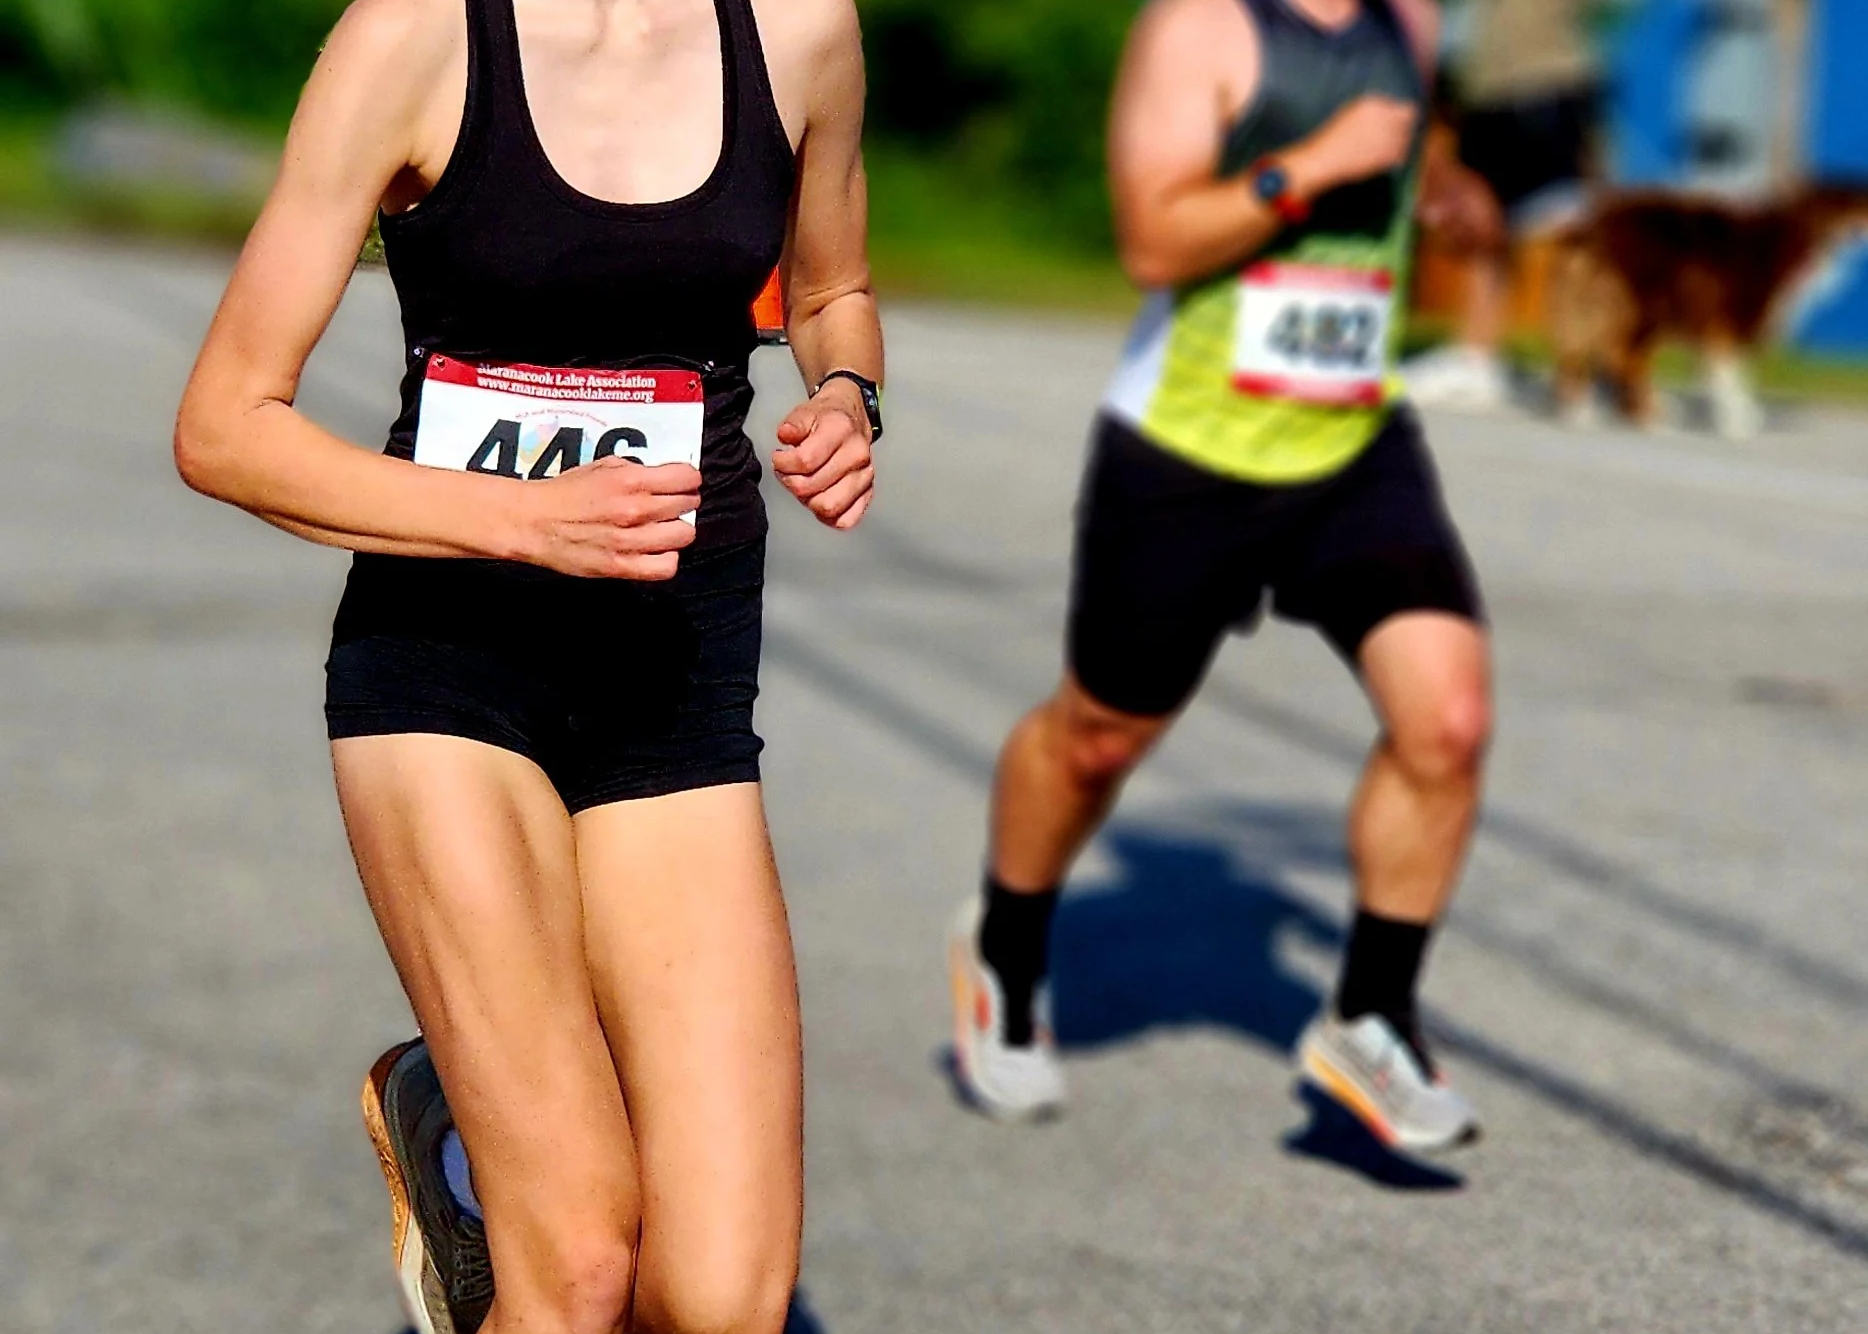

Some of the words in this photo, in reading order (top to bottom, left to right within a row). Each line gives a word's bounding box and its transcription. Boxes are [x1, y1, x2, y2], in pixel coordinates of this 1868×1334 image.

[477, 376, 655, 403] www.maranacooklakeme.org
[556, 373, 586, 386] Lake
[586, 374, 656, 388] Association
